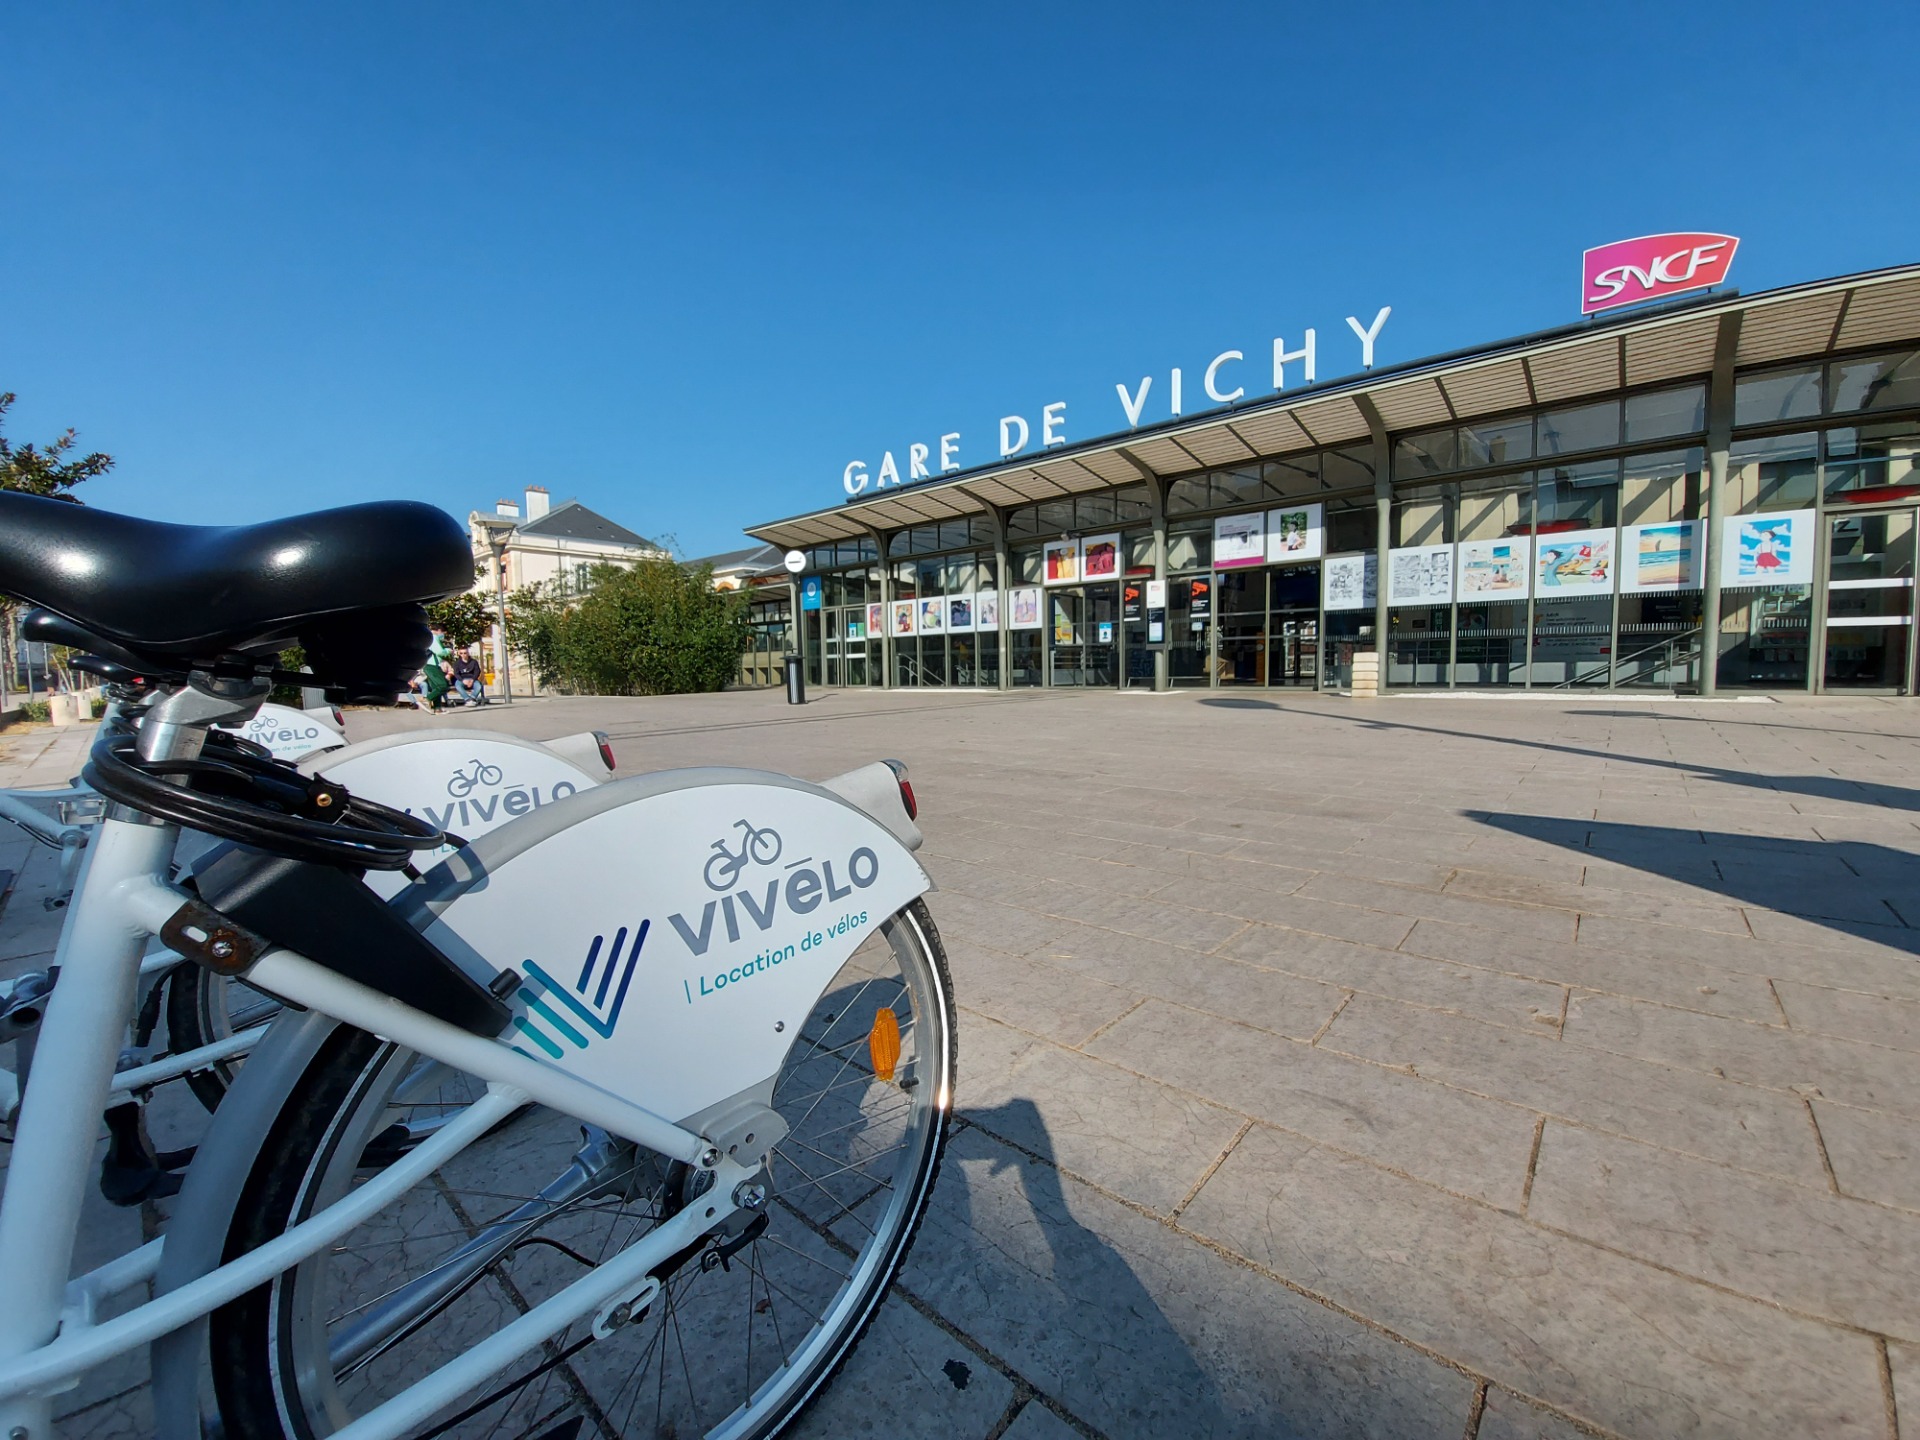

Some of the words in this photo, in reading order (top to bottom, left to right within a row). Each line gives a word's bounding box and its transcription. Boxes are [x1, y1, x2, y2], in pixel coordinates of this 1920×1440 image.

[1588, 241, 1728, 303] SNCF
[843, 432, 961, 496] GARE
[1000, 402, 1067, 457] DE
[1115, 306, 1392, 428] VICHY
[700, 945, 795, 996] Location
[800, 931, 823, 951] de
[826, 910, 868, 939] vélos
